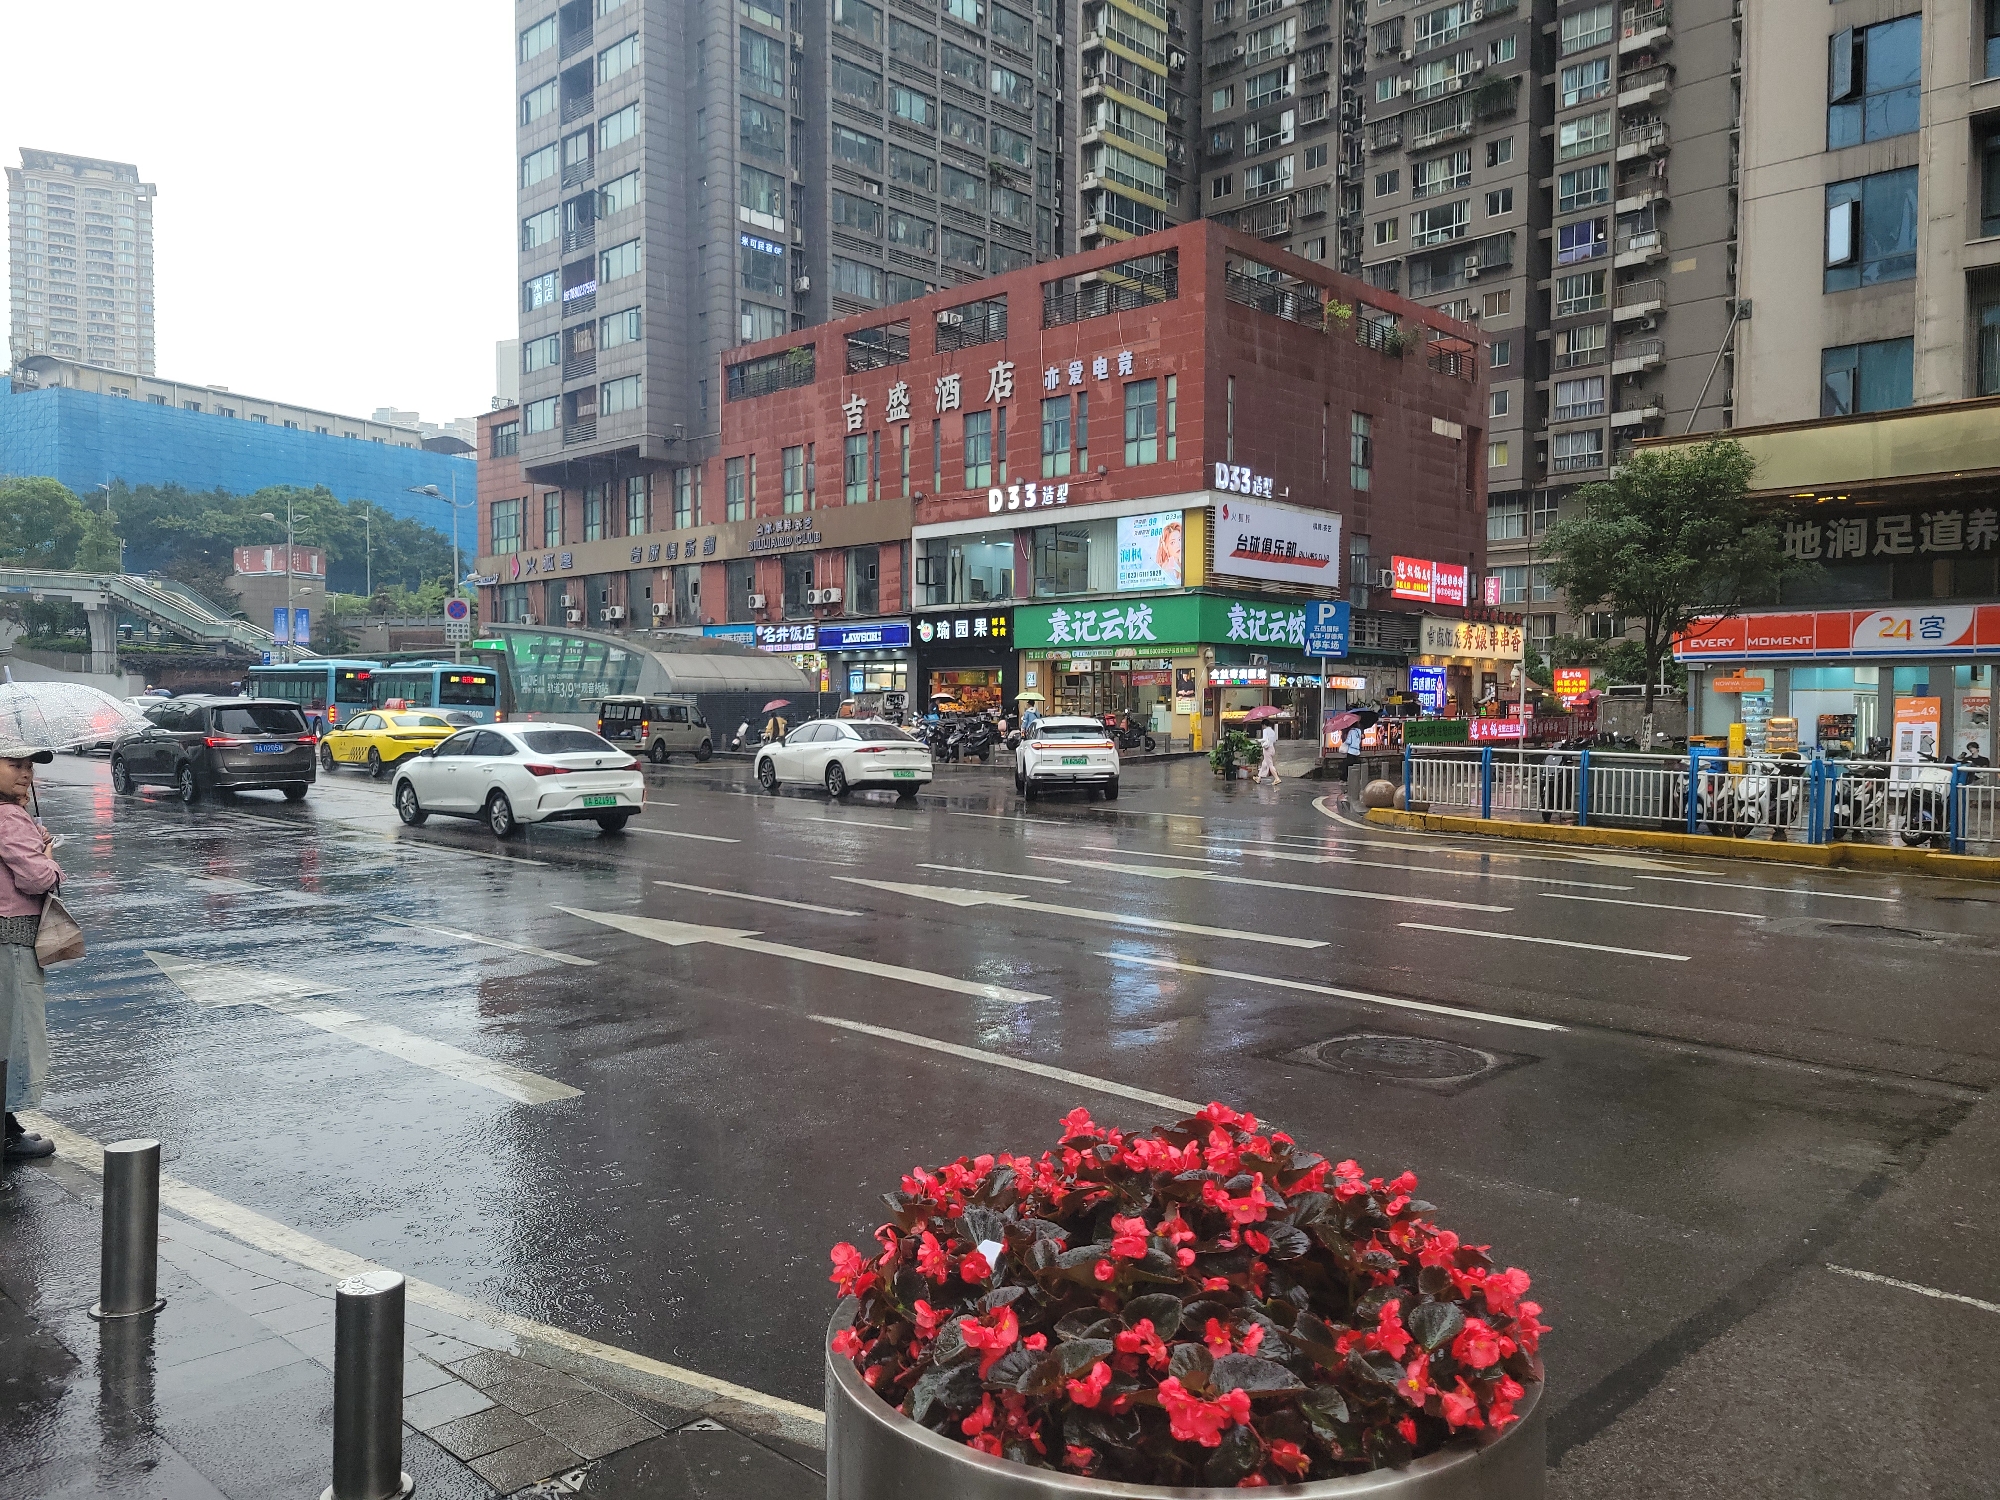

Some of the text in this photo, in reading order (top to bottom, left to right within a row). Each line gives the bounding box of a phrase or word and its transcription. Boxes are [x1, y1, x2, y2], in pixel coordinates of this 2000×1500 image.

[533, 274, 553, 293] 米可
[533, 288, 554, 307] 酒店
[1044, 350, 1133, 391] 亦爱电竞
[842, 360, 1015, 432] 吉盛酒店
[795, 531, 822, 546] CLUB
[1236, 533, 1298, 559] 台球俱乐部
[1046, 602, 1157, 645] 袁记云饺
[1226, 602, 1306, 646] 袁记云饺
[1318, 603, 1336, 625] P
[762, 624, 816, 643] 名井饭店
[842, 631, 877, 643] LAWSON
[936, 618, 988, 640] 瑜园果
[1877, 615, 1945, 641] 24客
[1312, 640, 1340, 650] 停车场
[1690, 636, 1813, 648] EVERY MOMENT
